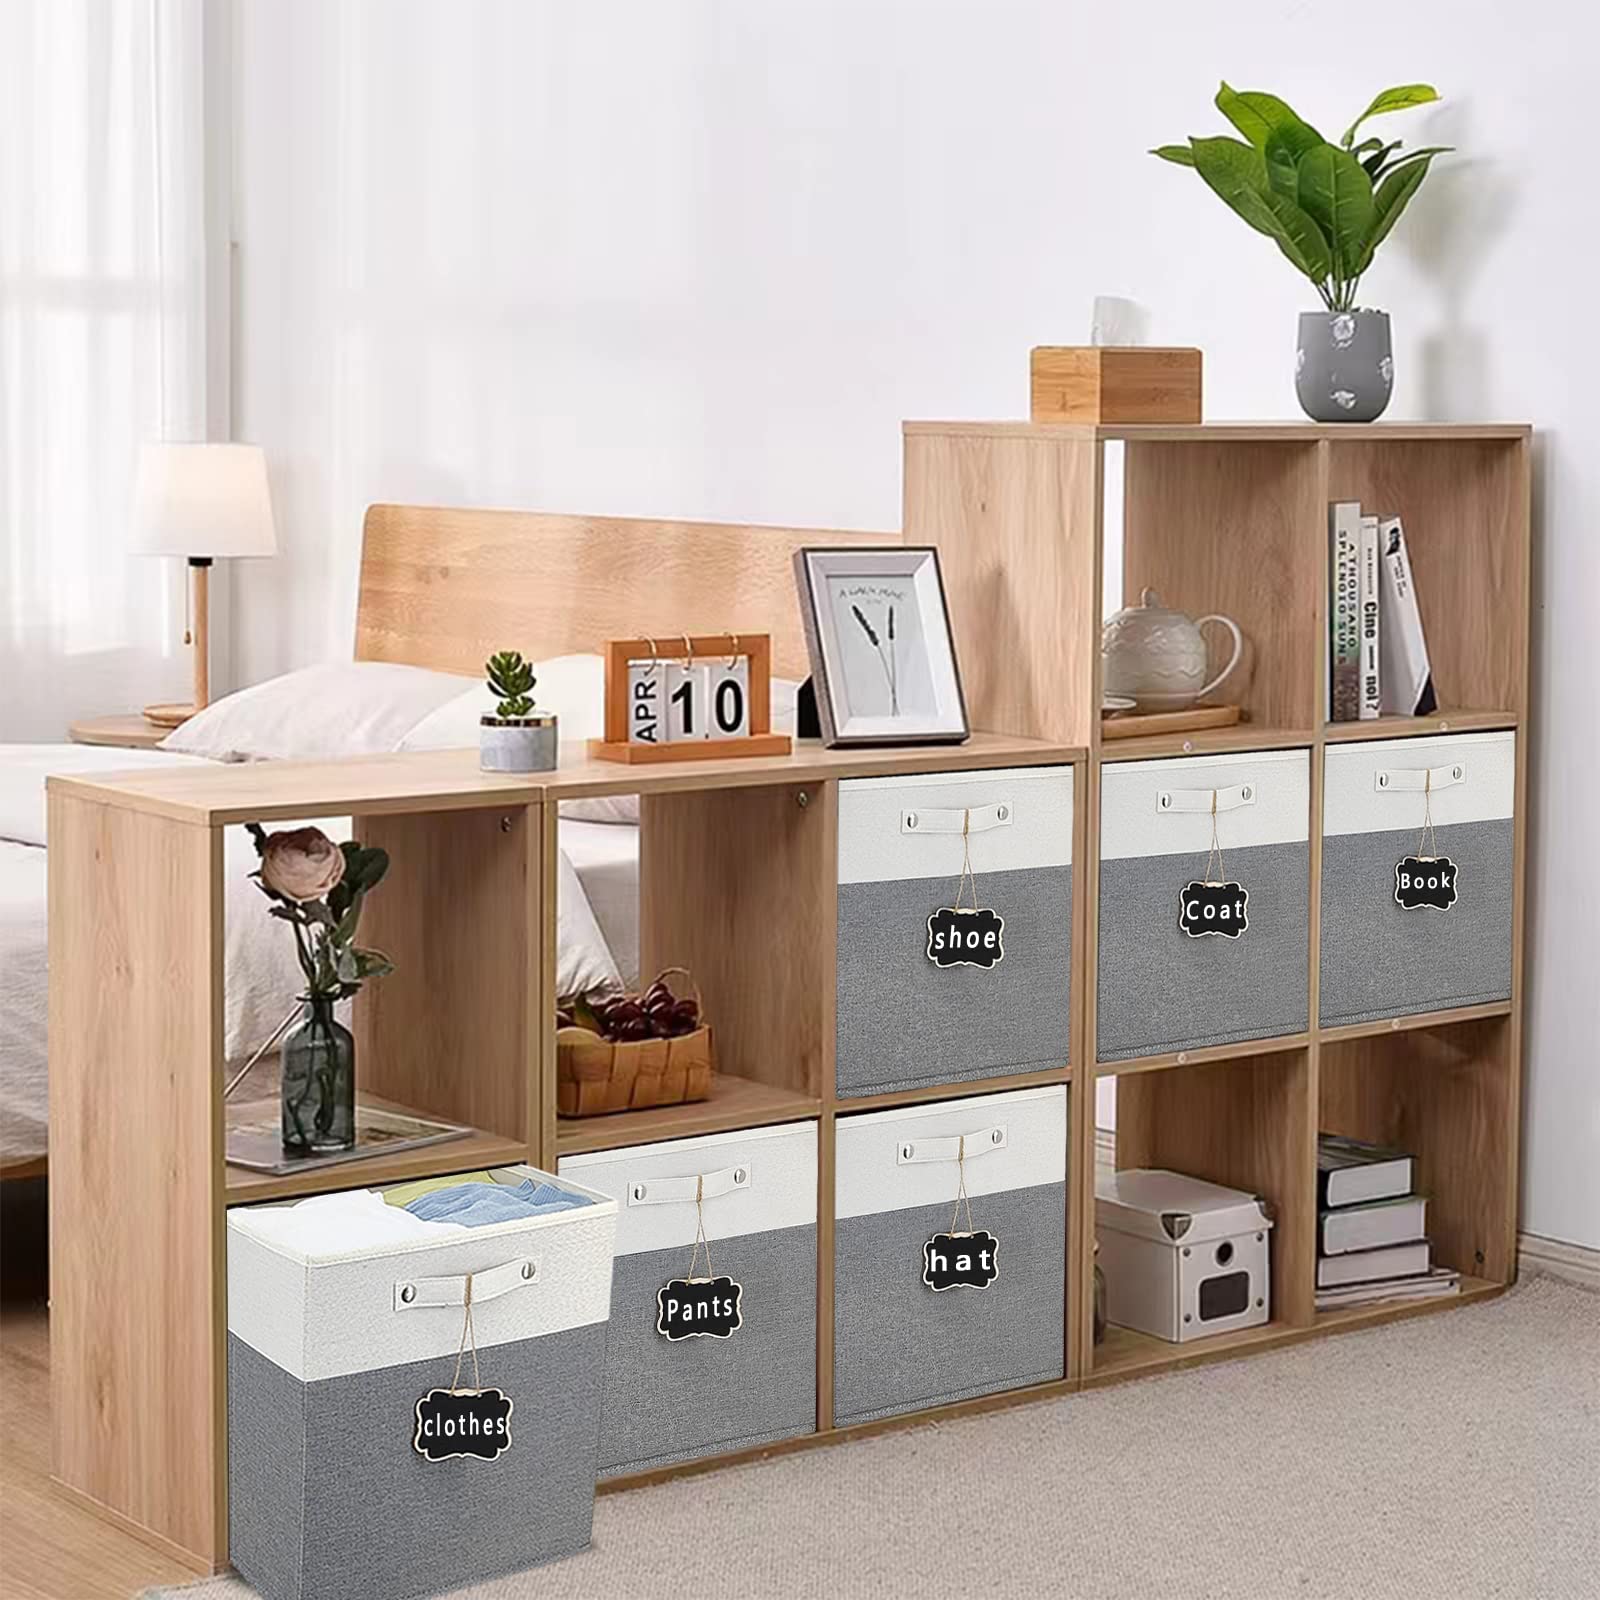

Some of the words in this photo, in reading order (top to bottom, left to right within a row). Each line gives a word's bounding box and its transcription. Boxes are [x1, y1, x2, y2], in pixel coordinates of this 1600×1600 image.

[635, 680, 657, 743] APR
[1401, 871, 1451, 889] Book
[1186, 900, 1242, 920] Coat
[934, 924, 996, 949] shoe
[930, 1248, 991, 1272] hat
[667, 1296, 733, 1322] Pants
[424, 1411, 505, 1437] clothes
